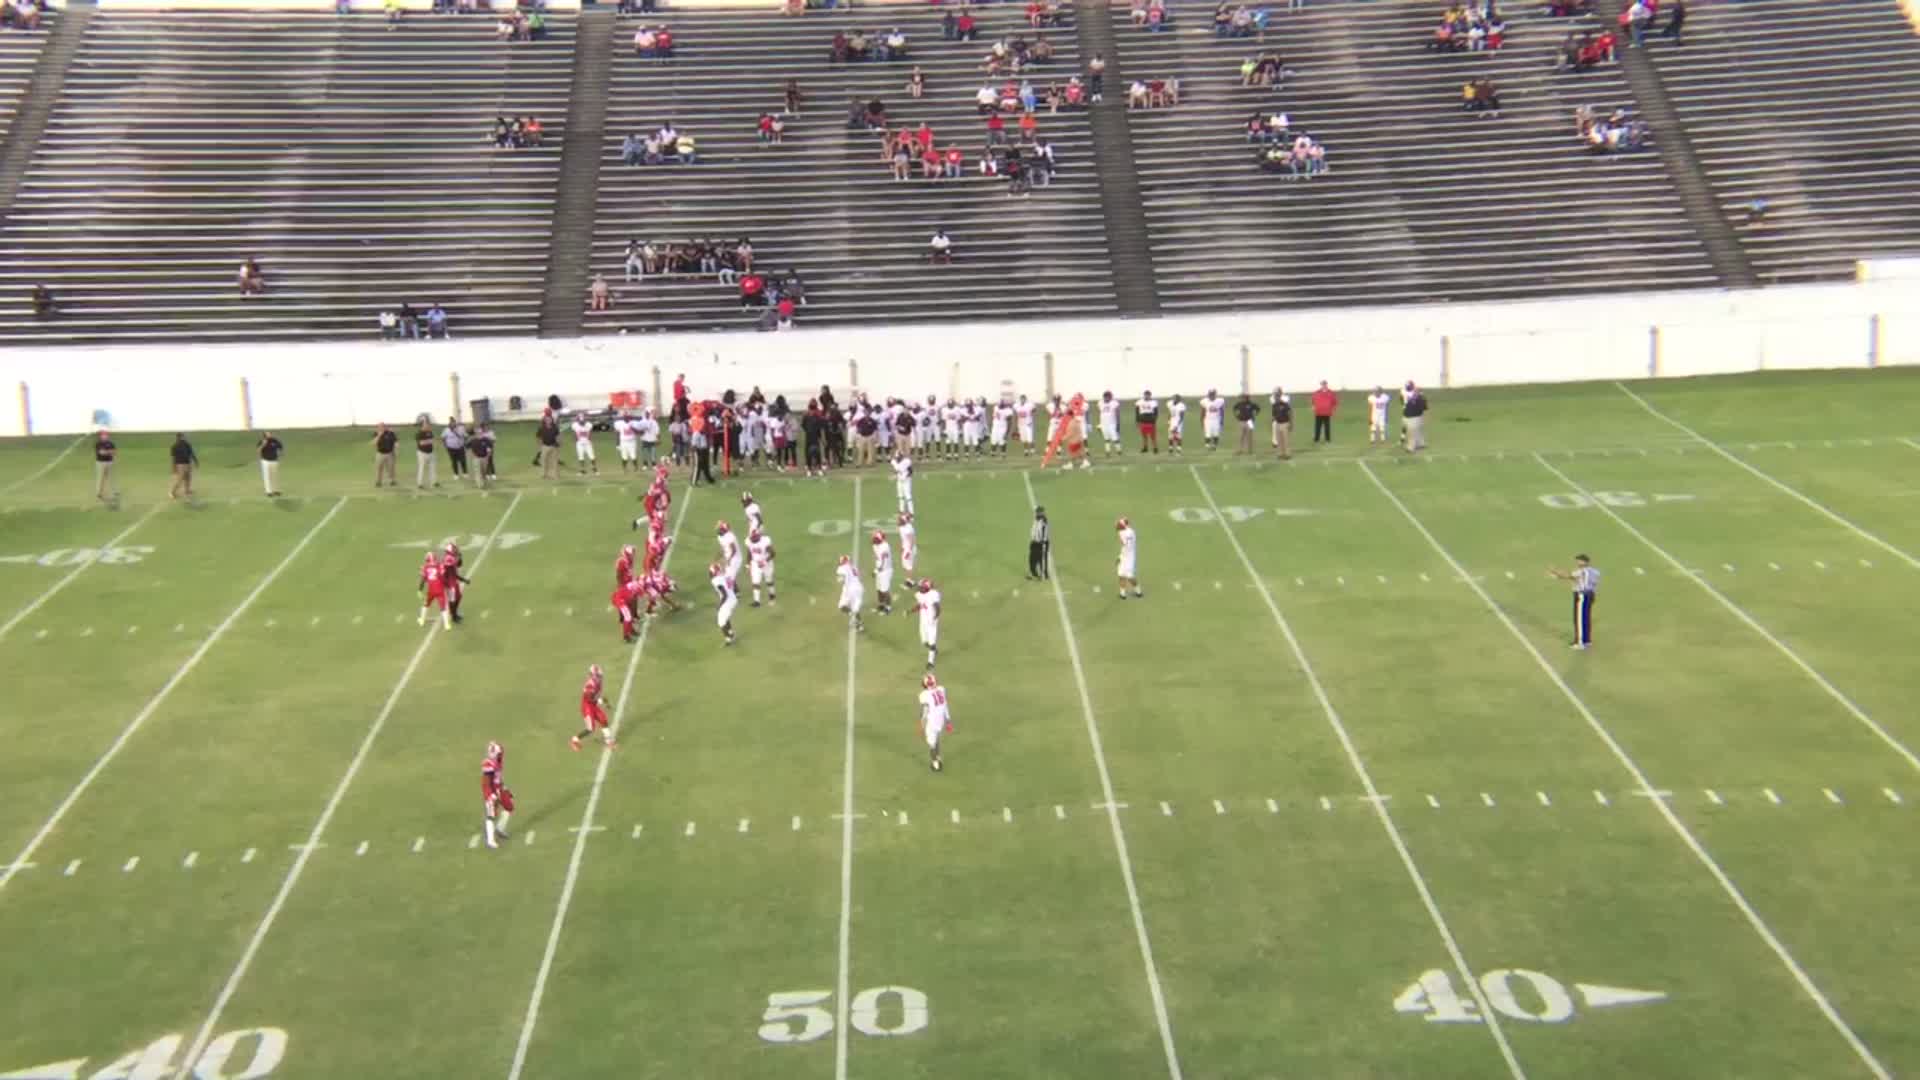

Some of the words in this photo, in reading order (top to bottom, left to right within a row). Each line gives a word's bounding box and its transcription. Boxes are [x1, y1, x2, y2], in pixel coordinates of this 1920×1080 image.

[757, 985, 929, 1042] 50
[1393, 968, 1574, 1022] 40
[86, 1026, 288, 1080] 40
